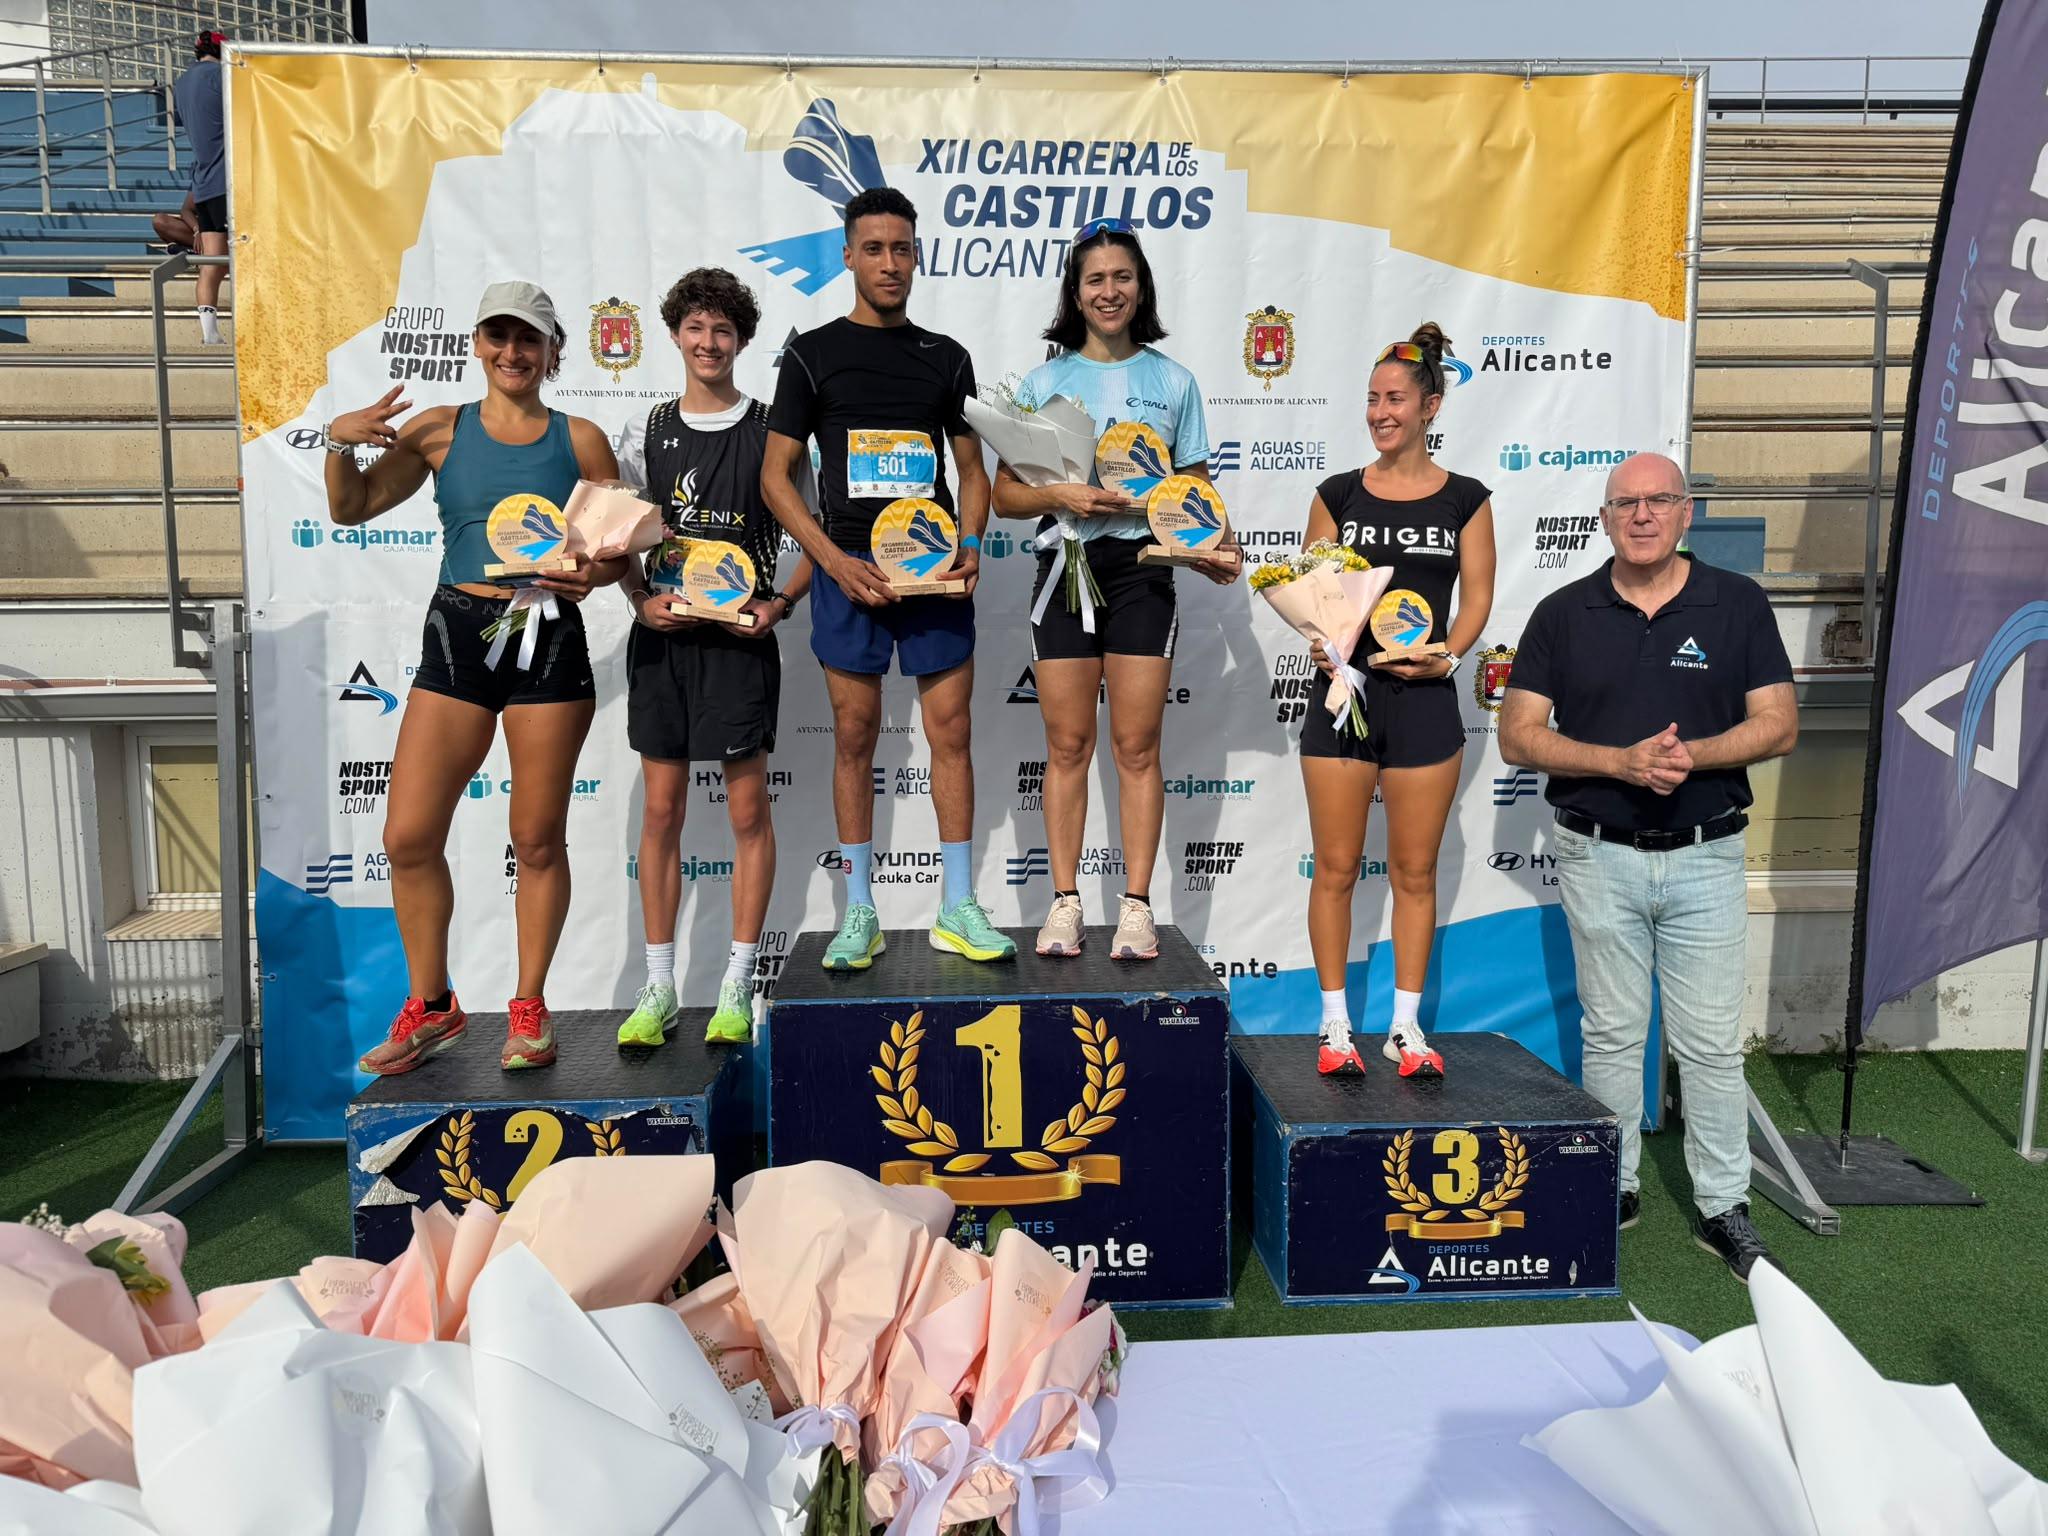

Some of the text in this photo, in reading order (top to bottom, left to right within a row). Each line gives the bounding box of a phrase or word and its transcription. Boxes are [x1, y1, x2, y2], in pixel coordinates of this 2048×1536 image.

[916, 139, 1160, 176] XII CARRERA
[1169, 142, 1193, 159] DE
[1165, 160, 1199, 177] LOS
[943, 184, 1214, 229] CASTILLOS
[385, 306, 444, 330] GRUPO
[380, 332, 470, 356] NOSTRE
[1482, 336, 1545, 346] DEPORTES
[1481, 348, 1612, 372] Alicante
[389, 357, 467, 382] SPORT
[555, 390, 623, 398] AYUNTAMIENTO
[1251, 441, 1325, 455] AGUAS DE
[878, 456, 909, 476] 501
[1250, 457, 1325, 470] ALICANTE
[685, 510, 746, 526] ZENIX
[1535, 516, 1599, 533] NOSTRE
[331, 524, 437, 550] cajamar
[1233, 531, 1301, 546] UNDAI
[1535, 534, 1590, 551] SPORT
[1534, 552, 1568, 569] .COM
[1670, 659, 1708, 670] Alicante
[339, 779, 390, 796] SPOR
[1163, 774, 1255, 799] cajamar
[340, 797, 376, 814] .COM
[1080, 848, 1110, 861] UAS
[1185, 842, 1244, 857] NOSTRE
[1077, 863, 1127, 875] ICANTE
[1184, 859, 1236, 875] SPORT
[870, 872, 939, 883] Leuka Car
[1184, 877, 1216, 892] .COM
[956, 1005, 1022, 1148] 1
[504, 1109, 563, 1202] 2
[1432, 1130, 1479, 1204] 3
[1051, 1237, 1148, 1268] ante
[1428, 1244, 1490, 1254] DEPORTES
[1428, 1255, 1550, 1277] Alicante
